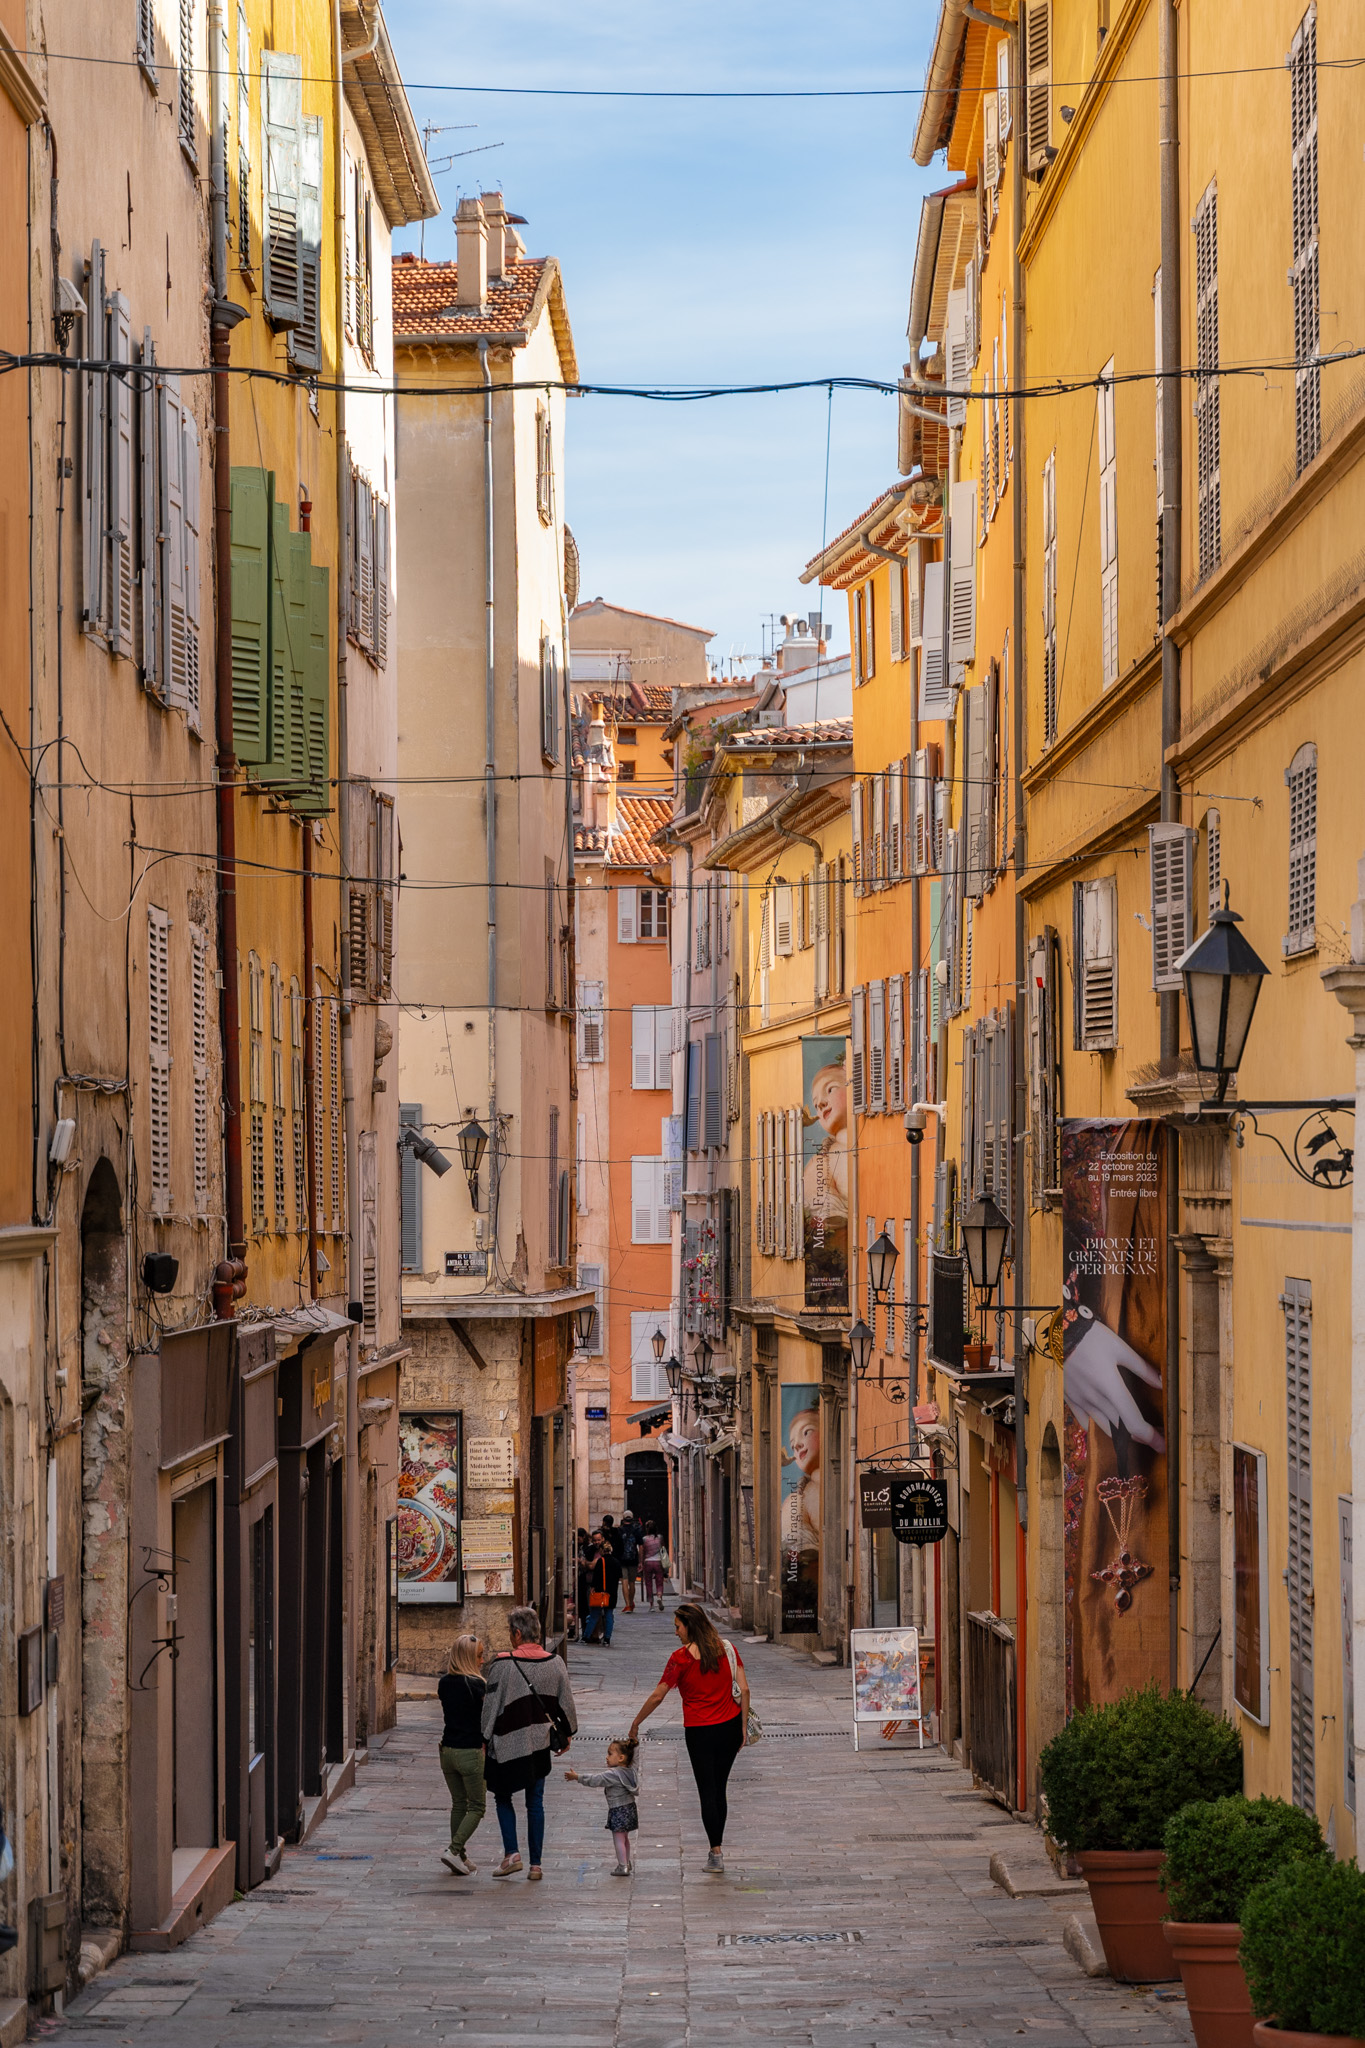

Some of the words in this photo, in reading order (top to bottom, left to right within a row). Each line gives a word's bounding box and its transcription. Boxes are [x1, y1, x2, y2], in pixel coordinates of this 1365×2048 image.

[1100, 1151, 1144, 1162] Exposition
[1146, 1151, 1157, 1160] du
[1088, 1162, 1099, 1171] 22
[1102, 1162, 1134, 1171] octobre
[1136, 1162, 1158, 1171] 2022
[812, 1144, 826, 1206] Fragonard
[1101, 1173, 1111, 1181] 19
[1136, 1173, 1158, 1181] 2023
[1110, 1188, 1137, 1198] Entrée
[1140, 1188, 1158, 1198] libre
[812, 1214, 825, 1249] Musé
[1086, 1238, 1134, 1249] BIJOUX
[1139, 1238, 1157, 1249] ET
[1068, 1251, 1134, 1262] GRENATS
[1138, 1251, 1157, 1262] DE
[1075, 1263, 1157, 1275] PERPIGNAN
[900, 1482, 944, 1507] GOURMANDISES
[786, 1481, 800, 1542] Fragonard
[913, 1518, 941, 1526] MOULIN
[786, 1546, 798, 1582] Musée
